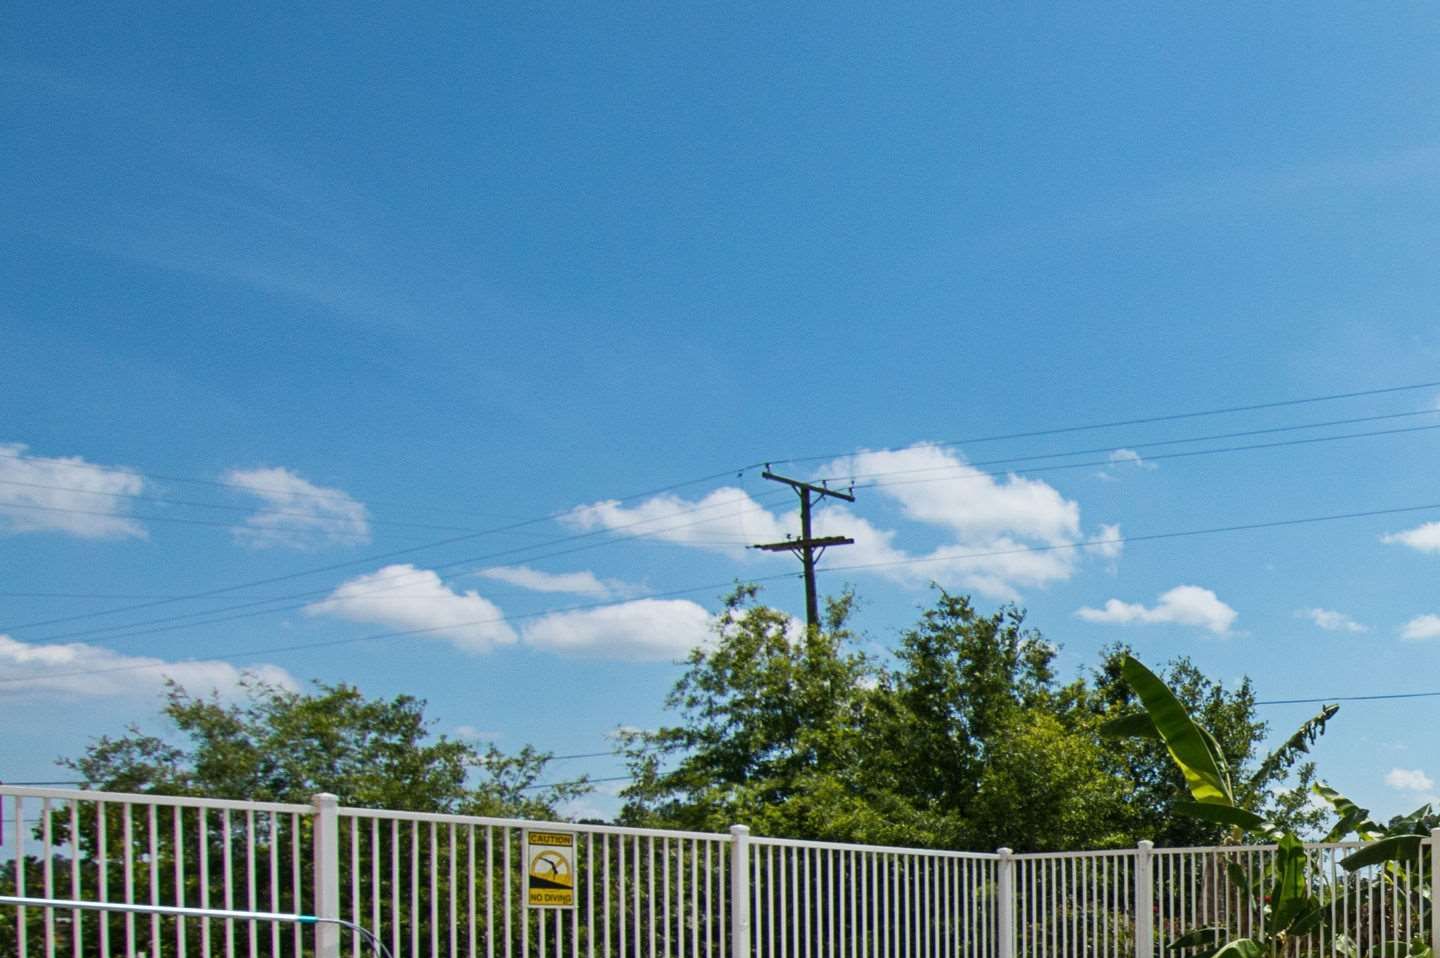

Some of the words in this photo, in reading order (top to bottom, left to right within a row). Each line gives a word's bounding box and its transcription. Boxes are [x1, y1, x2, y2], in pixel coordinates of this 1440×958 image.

[531, 834, 571, 844] CAUTION
[530, 893, 542, 901] NO
[544, 894, 571, 904] DIVING
